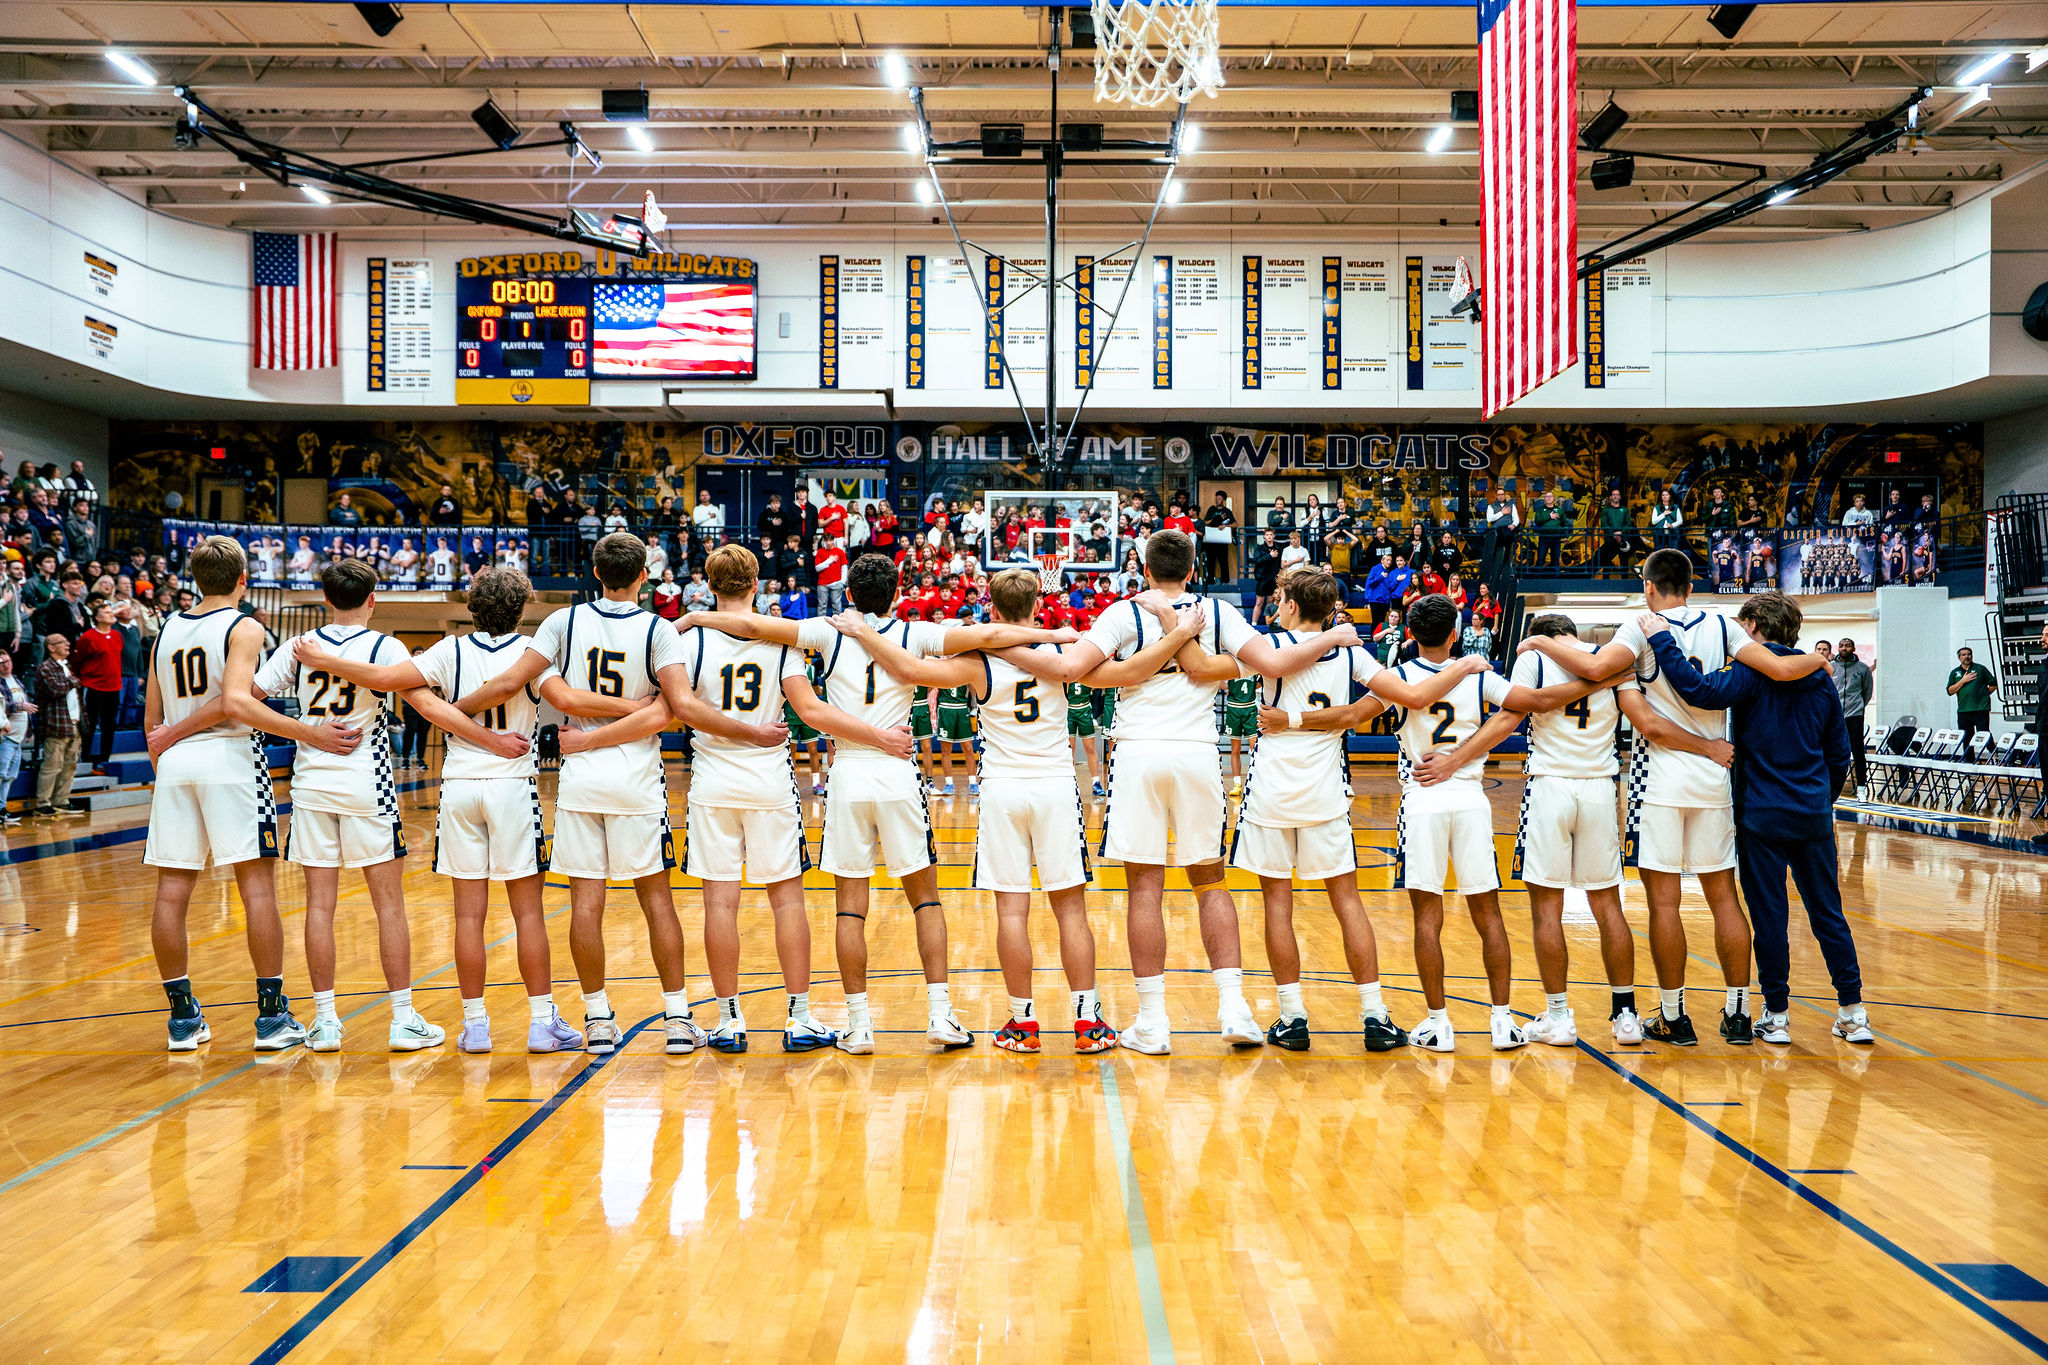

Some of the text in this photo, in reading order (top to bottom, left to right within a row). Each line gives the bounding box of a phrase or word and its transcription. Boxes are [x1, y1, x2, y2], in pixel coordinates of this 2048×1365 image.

[461, 252, 582, 278] OXFORD
[631, 252, 753, 278] WILDCATS
[492, 281, 555, 304] 08:00
[467, 305, 503, 317] OXFORD
[510, 311, 534, 319] PERIOD
[535, 305, 587, 317] LAKE ORION
[910, 259, 922, 387] GIRLS GOLF
[989, 258, 1001, 386] SOFTBALL
[1246, 259, 1258, 386] VOLLEYBALL
[1408, 270, 1421, 361] TENNIS
[371, 270, 384, 388] BASKETBALL
[481, 318, 496, 341] 0
[523, 322, 530, 338] 1
[570, 318, 586, 341] 0
[1078, 267, 1091, 387] SOCCER
[1324, 269, 1339, 387] BOWLING
[466, 349, 480, 368] 0
[572, 349, 586, 368] 0
[1156, 326, 1169, 386] TRACK
[458, 369, 480, 377] SCORE
[564, 369, 586, 377] SCORE
[703, 425, 885, 459] OXFORD
[930, 436, 1021, 461] HALL
[1055, 437, 1156, 461] FAME
[1210, 434, 1490, 469] WILDCATS
[1783, 527, 1875, 540] OXFORD WILDCATS
[1735, 578, 1743, 587] 22
[1768, 578, 1776, 587] 10
[1905, 574, 1909, 584] 5
[171, 646, 208, 699] 10
[587, 646, 626, 697] 15
[864, 659, 876, 705] 1
[307, 670, 356, 717] 23
[720, 662, 762, 712] 13
[1013, 676, 1040, 724] 5
[1240, 682, 1248, 694] 4
[1428, 701, 1457, 746] 2
[1564, 695, 1591, 730] 4
